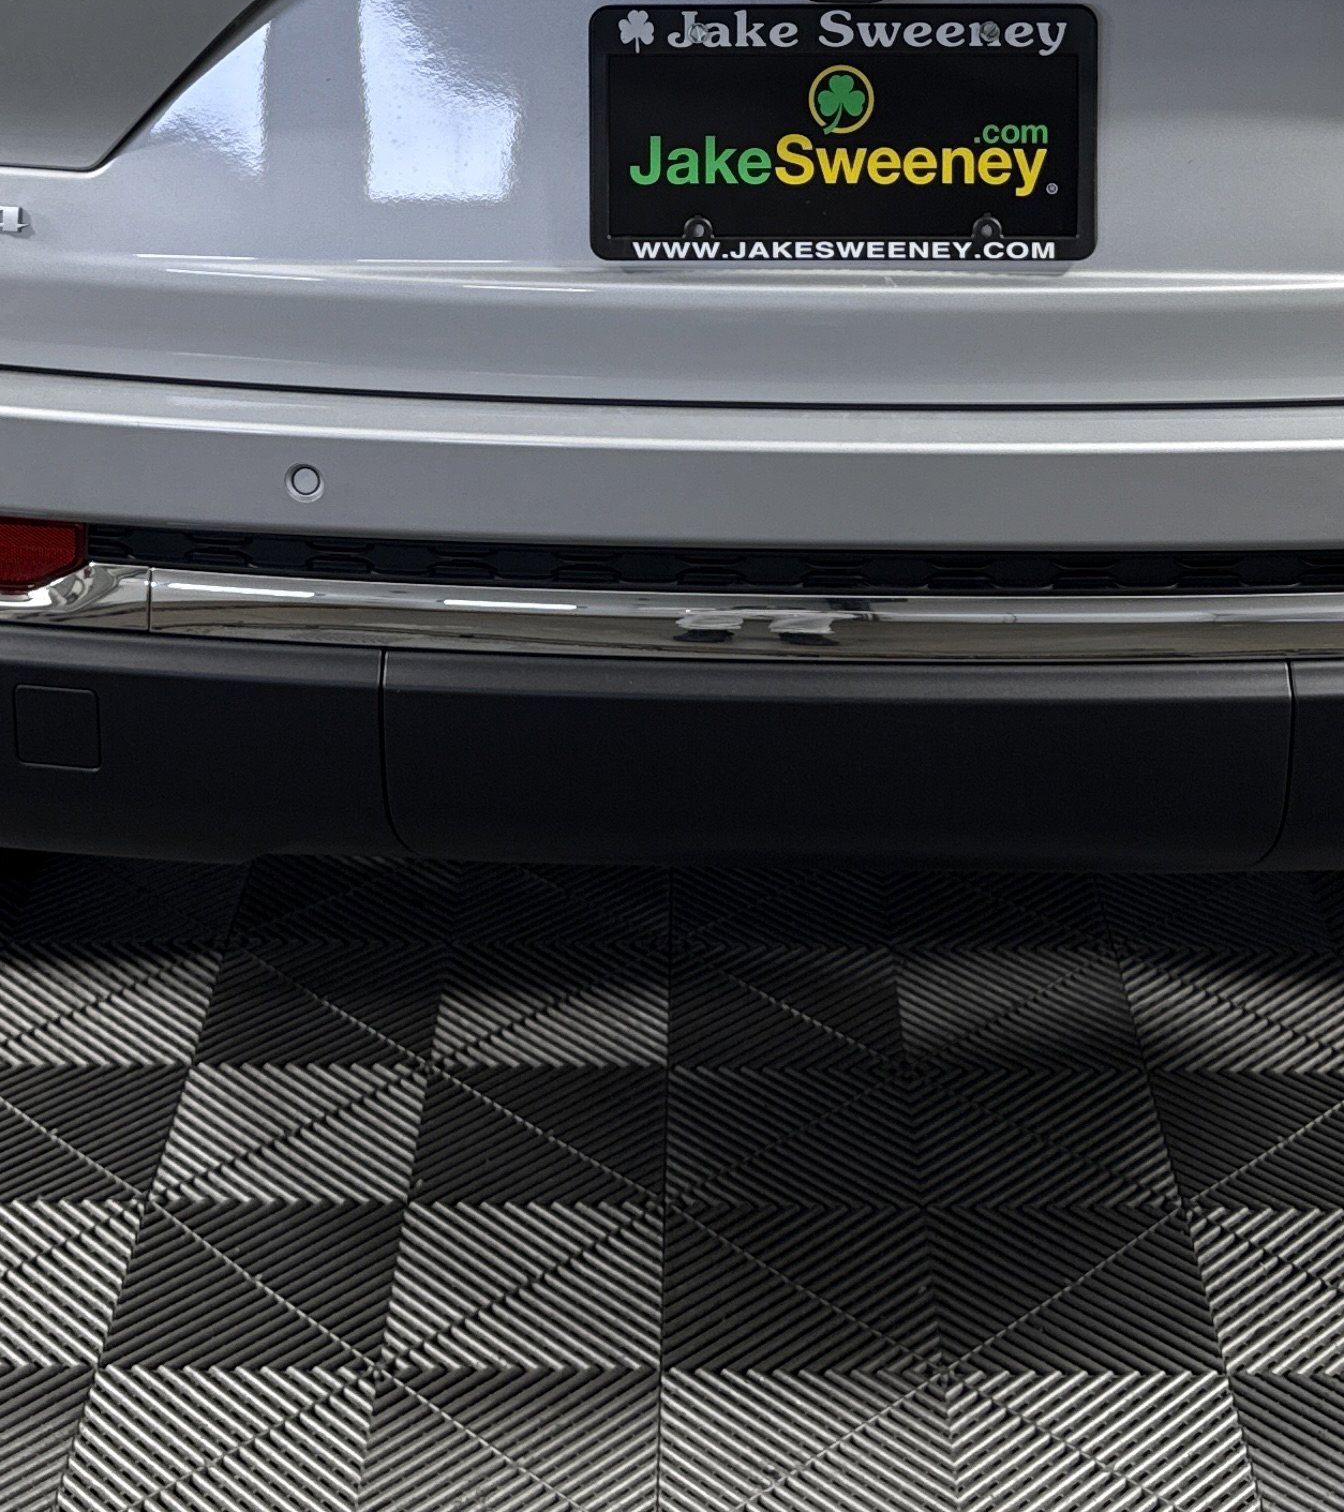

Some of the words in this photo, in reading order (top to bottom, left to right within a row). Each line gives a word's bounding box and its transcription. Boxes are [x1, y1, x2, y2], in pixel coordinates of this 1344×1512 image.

[667, 9, 799, 48] Jake
[818, 10, 1067, 56] Sweeney
[633, 241, 1056, 259] WWW.JAKESWEENEY.COM
